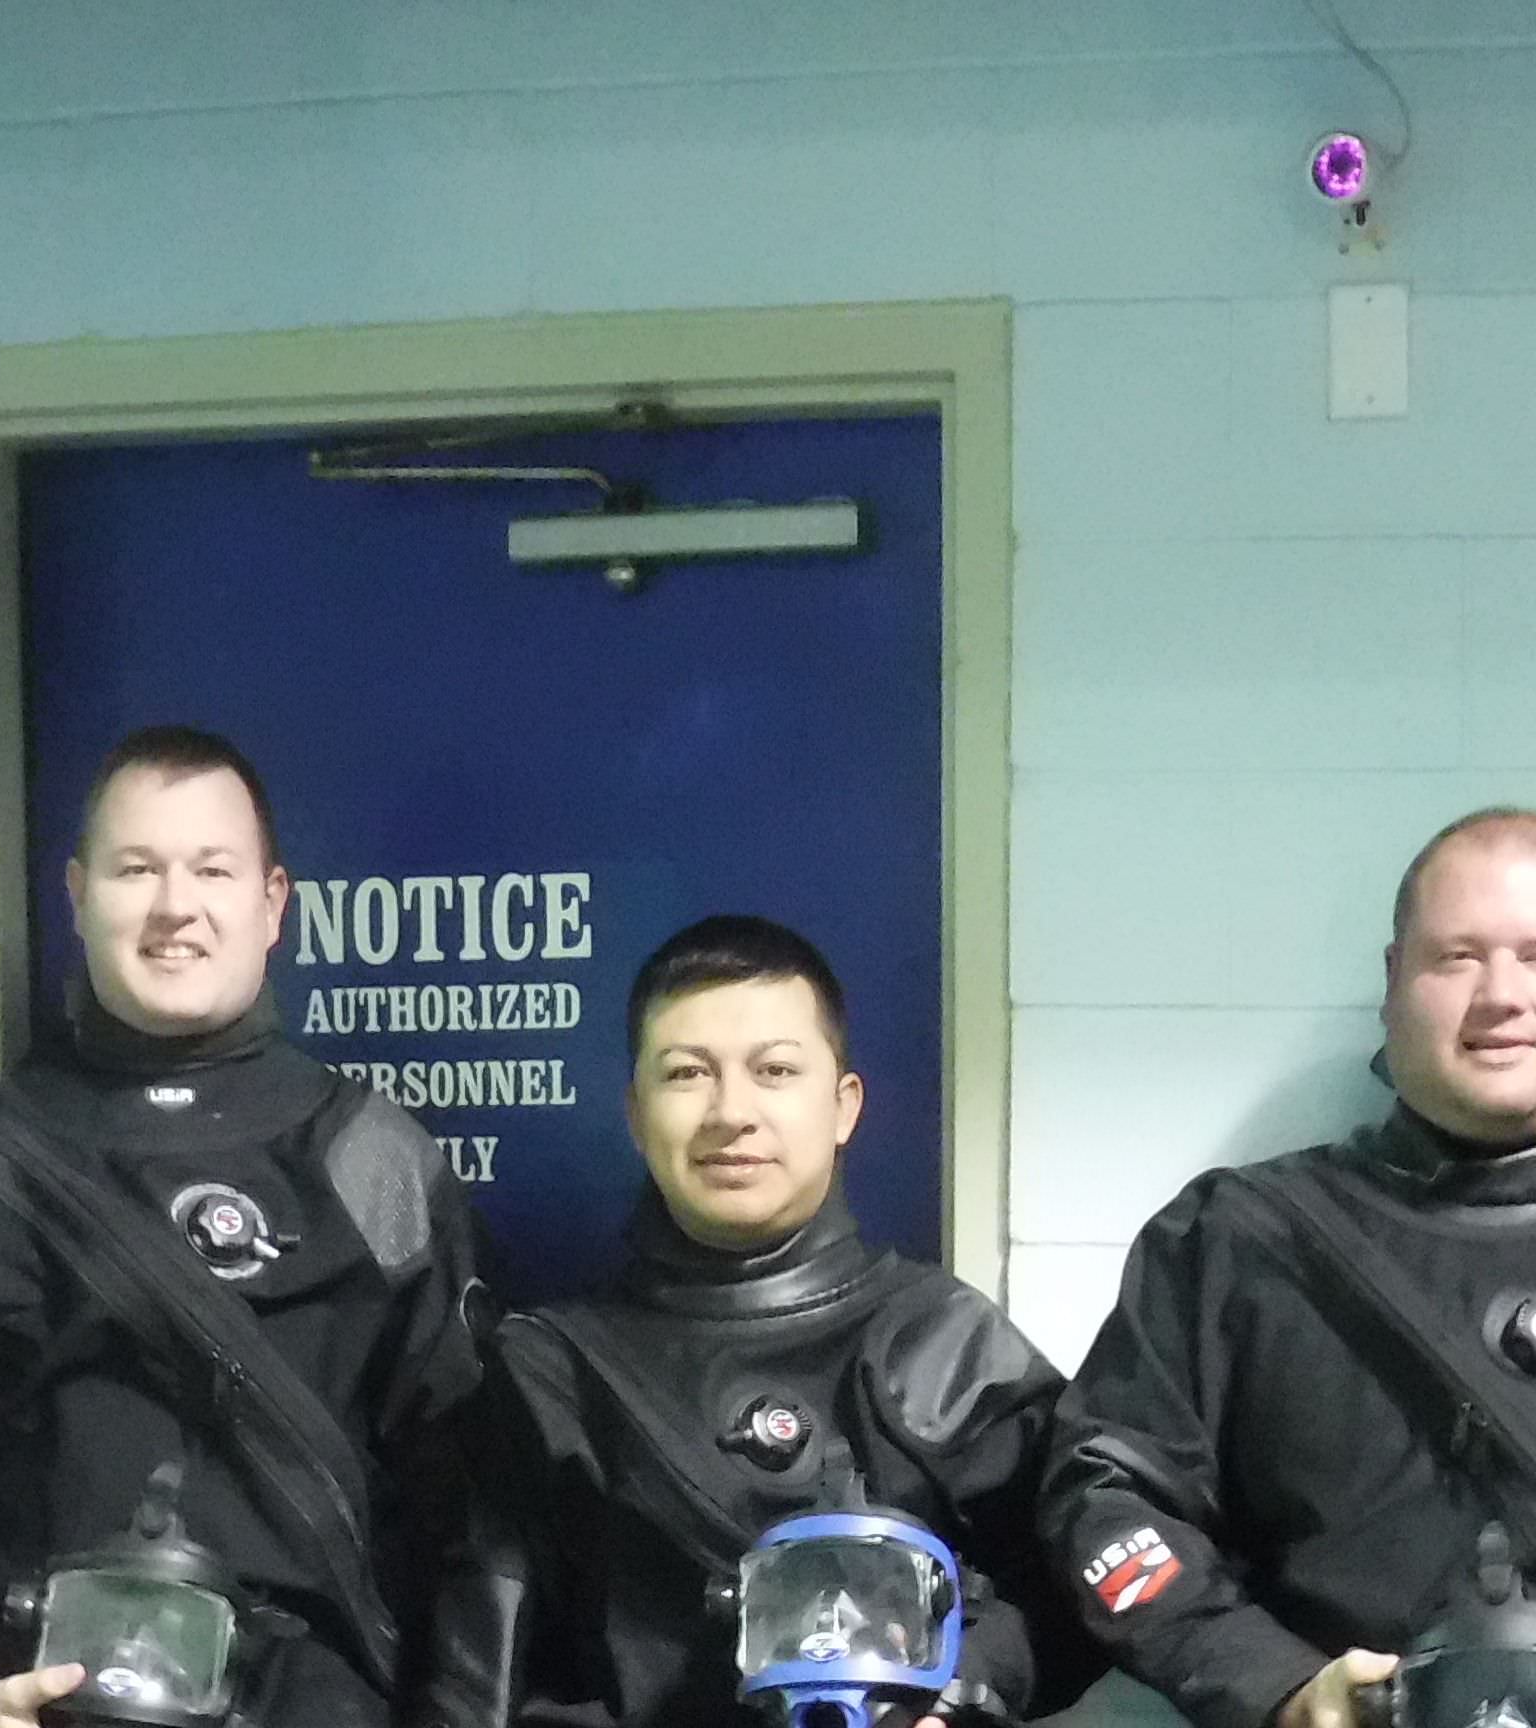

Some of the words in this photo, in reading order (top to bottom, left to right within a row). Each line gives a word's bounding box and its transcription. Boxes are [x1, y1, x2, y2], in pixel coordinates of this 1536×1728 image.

[295, 872, 593, 965] NOTICE
[303, 982, 581, 1034] AUTHORIZED
[325, 1059, 577, 1108] RSONNEL
[435, 1136, 500, 1182] LY
